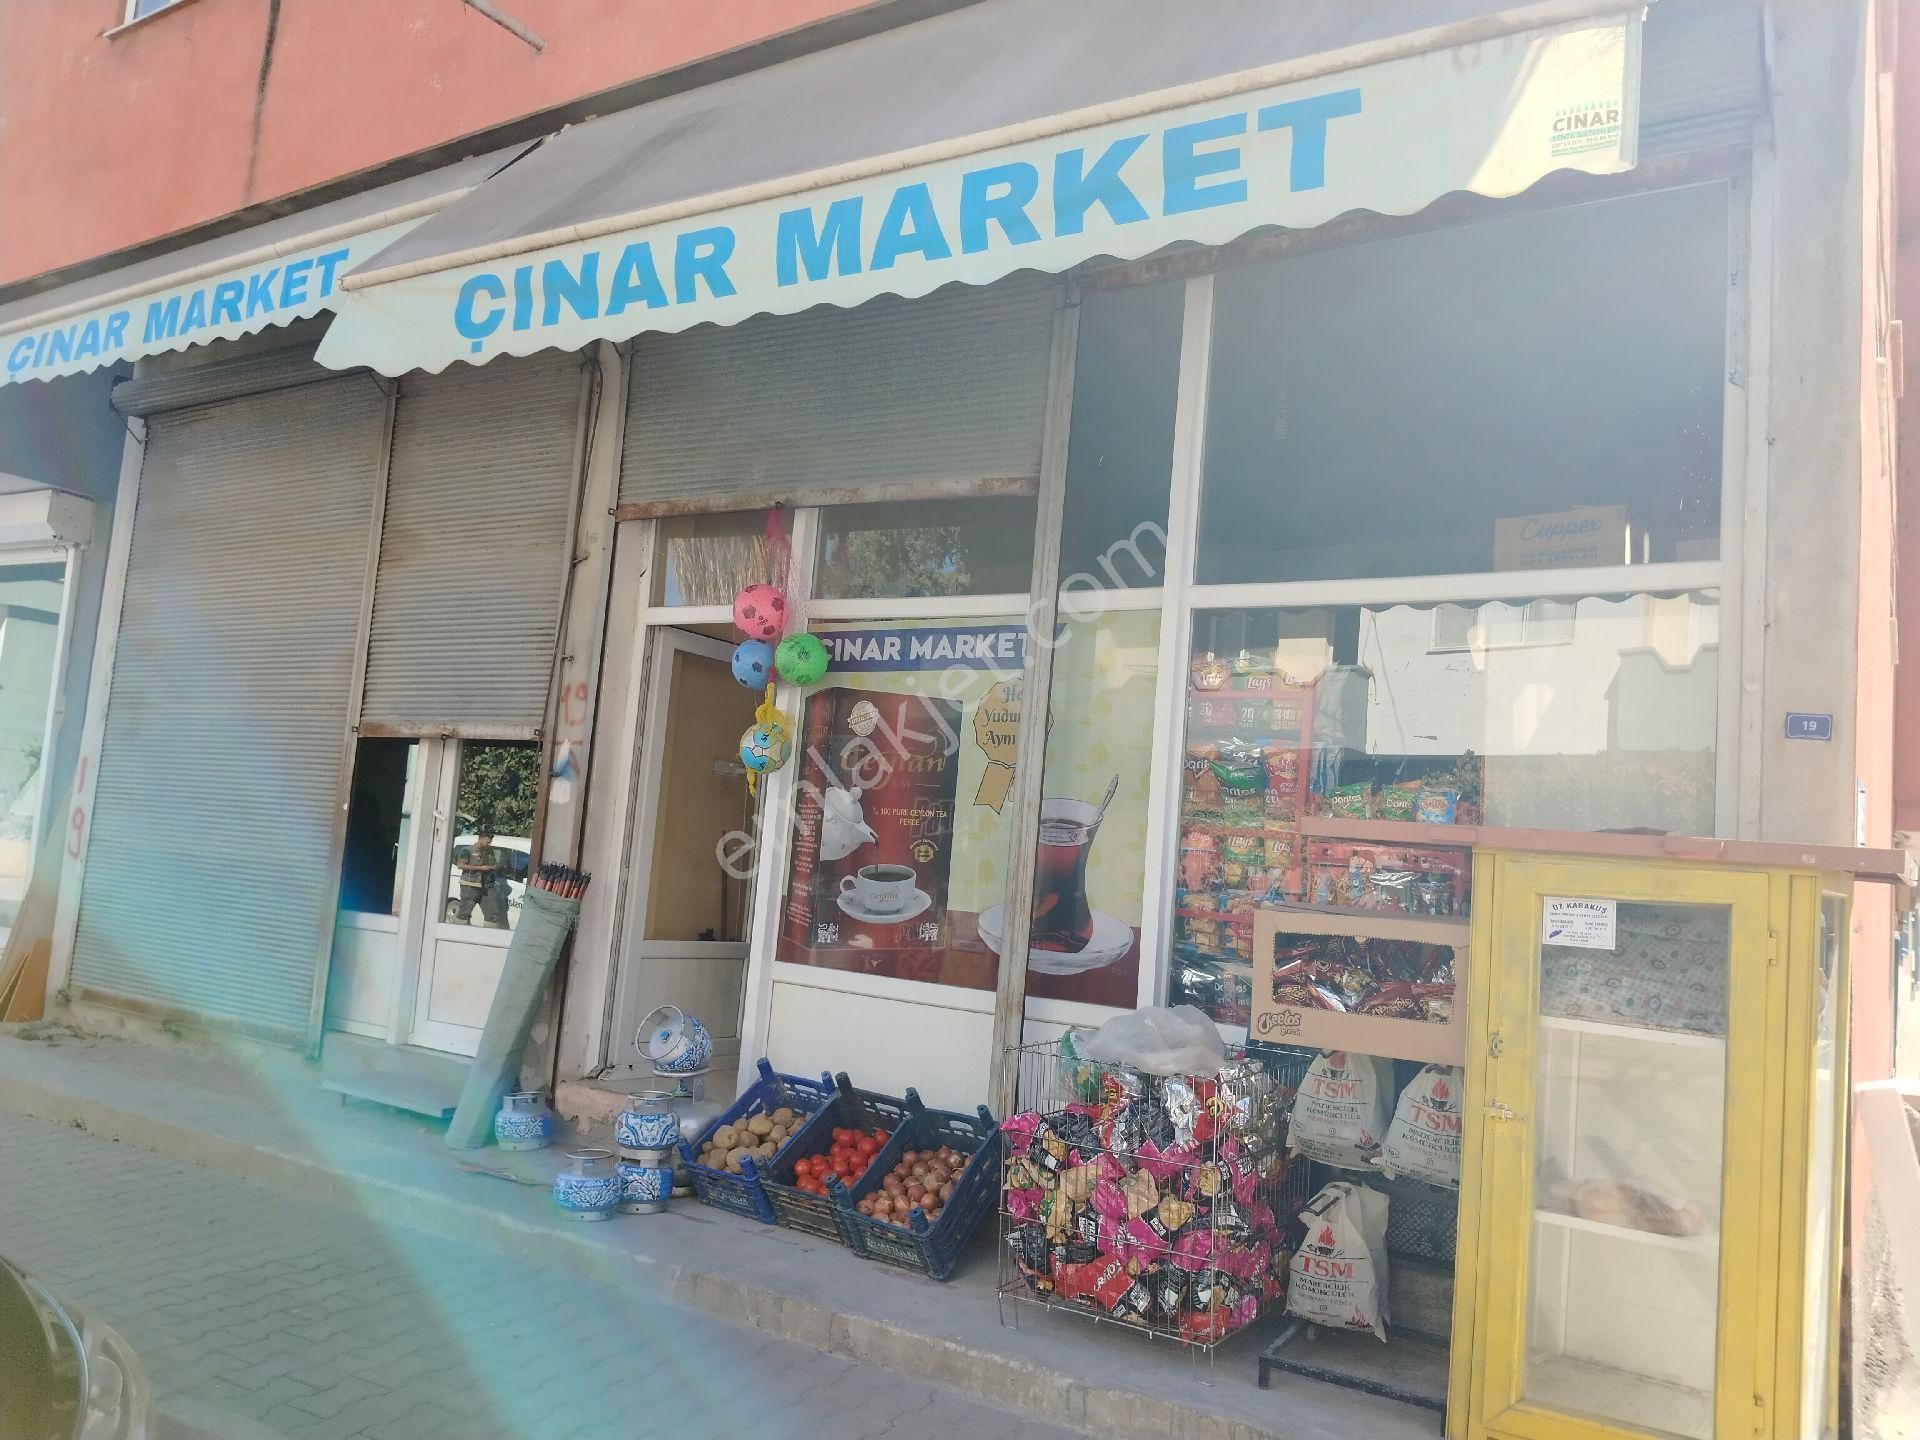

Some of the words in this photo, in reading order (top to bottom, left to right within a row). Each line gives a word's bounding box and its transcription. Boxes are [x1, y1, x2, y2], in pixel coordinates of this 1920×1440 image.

[455, 226, 737, 354] ÇINAR
[776, 88, 1362, 288] MARKET
[6, 310, 131, 380] ÇINAR
[142, 248, 350, 345] MARKET
[982, 708, 1021, 727] Yudu
[1802, 720, 1817, 731] 19
[1257, 1010, 1302, 1035] Cheetos
[1314, 1078, 1360, 1100] TSM
[1412, 1104, 1462, 1134] TSM
[1298, 1255, 1354, 1279] TSM
